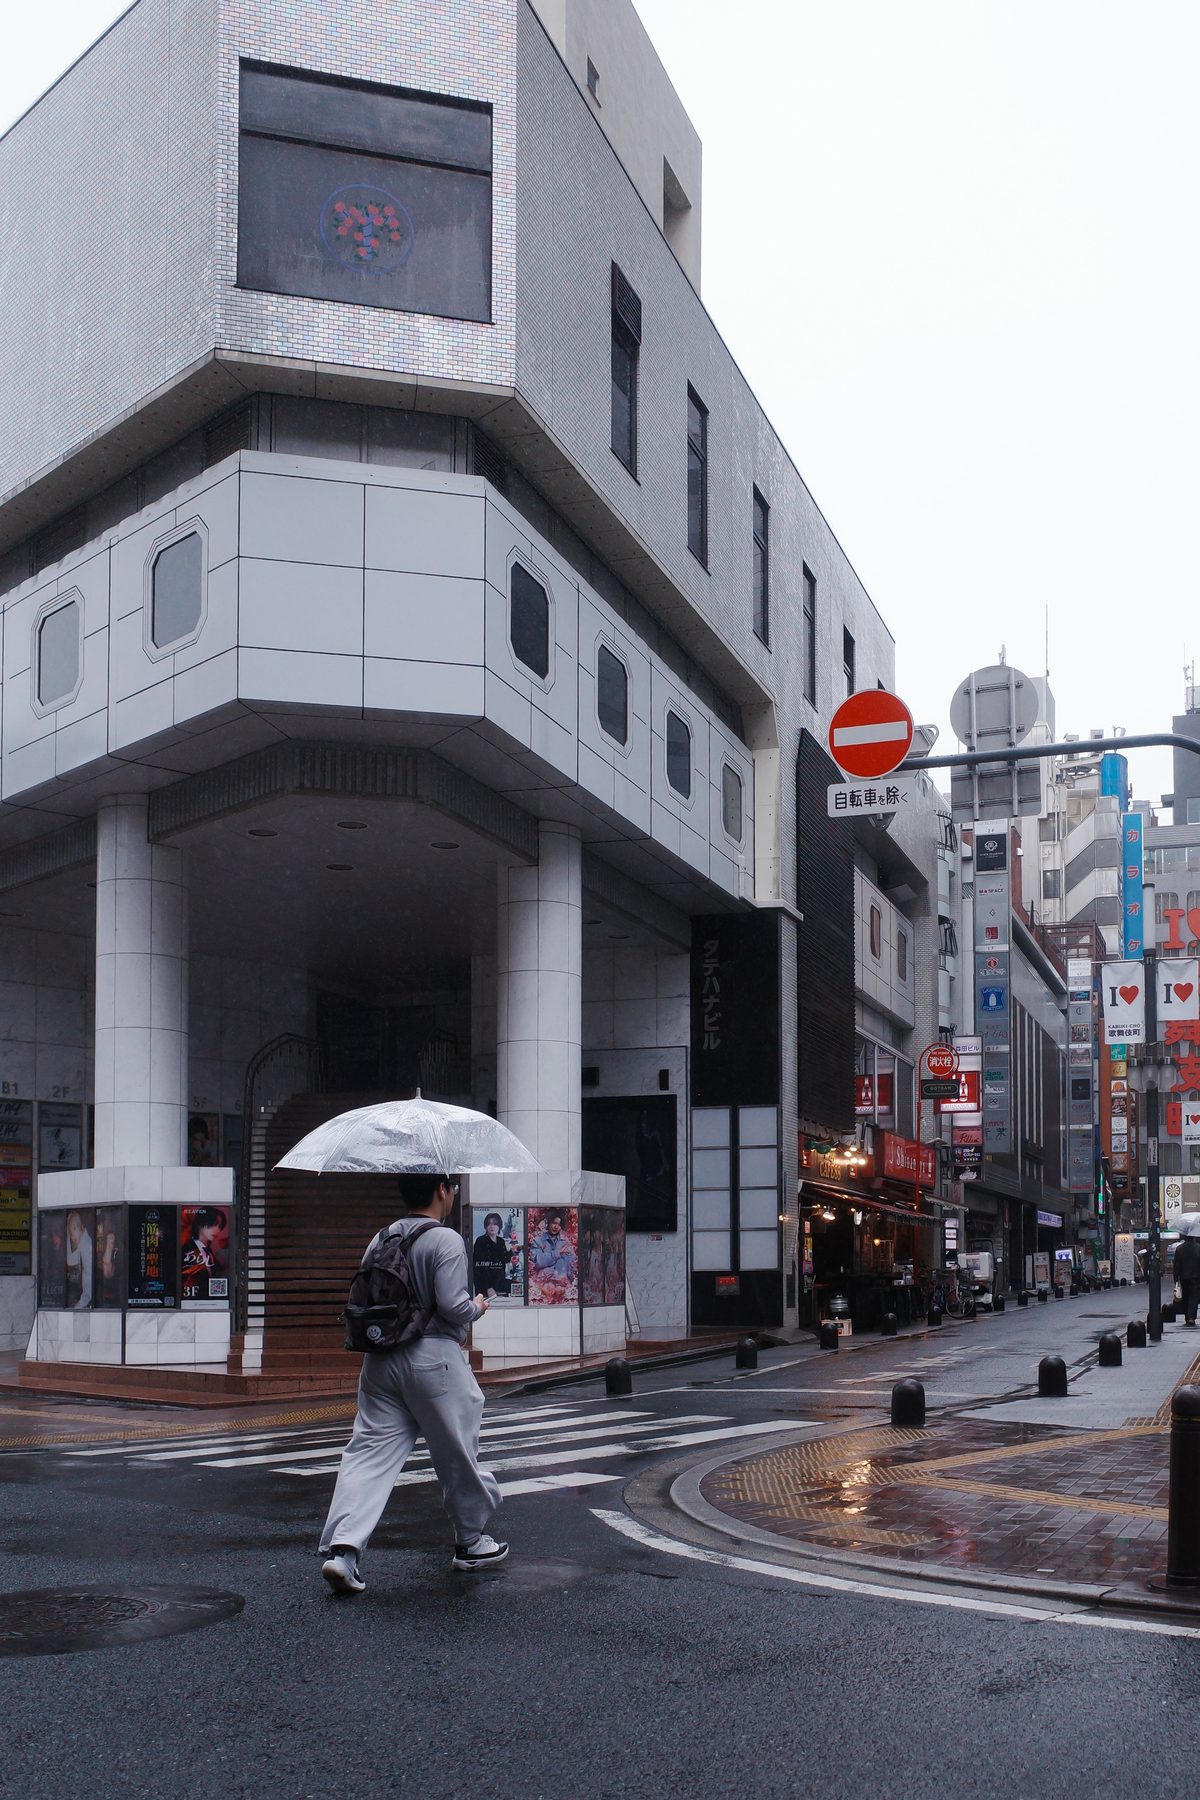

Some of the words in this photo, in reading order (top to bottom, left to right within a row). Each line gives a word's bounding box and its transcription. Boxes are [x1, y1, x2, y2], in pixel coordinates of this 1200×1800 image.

[835, 786, 908, 809] 自転車を除く
[1127, 830, 1140, 952] カラオケ
[1163, 908, 1185, 949] I
[702, 939, 722, 1050] タテハナビル
[1109, 986, 1119, 1007] I
[1163, 983, 1173, 1004] I
[1108, 1029, 1140, 1038] 歌舞伎町
[929, 1056, 953, 1068] 消火栓
[2, 1080, 18, 1094] B1
[51, 1084, 71, 1098] 2F
[509, 1207, 522, 1218] 3F
[1167, 1201, 1180, 1209] UP
[183, 1251, 215, 1267] あらし
[183, 1286, 199, 1297] 3F
